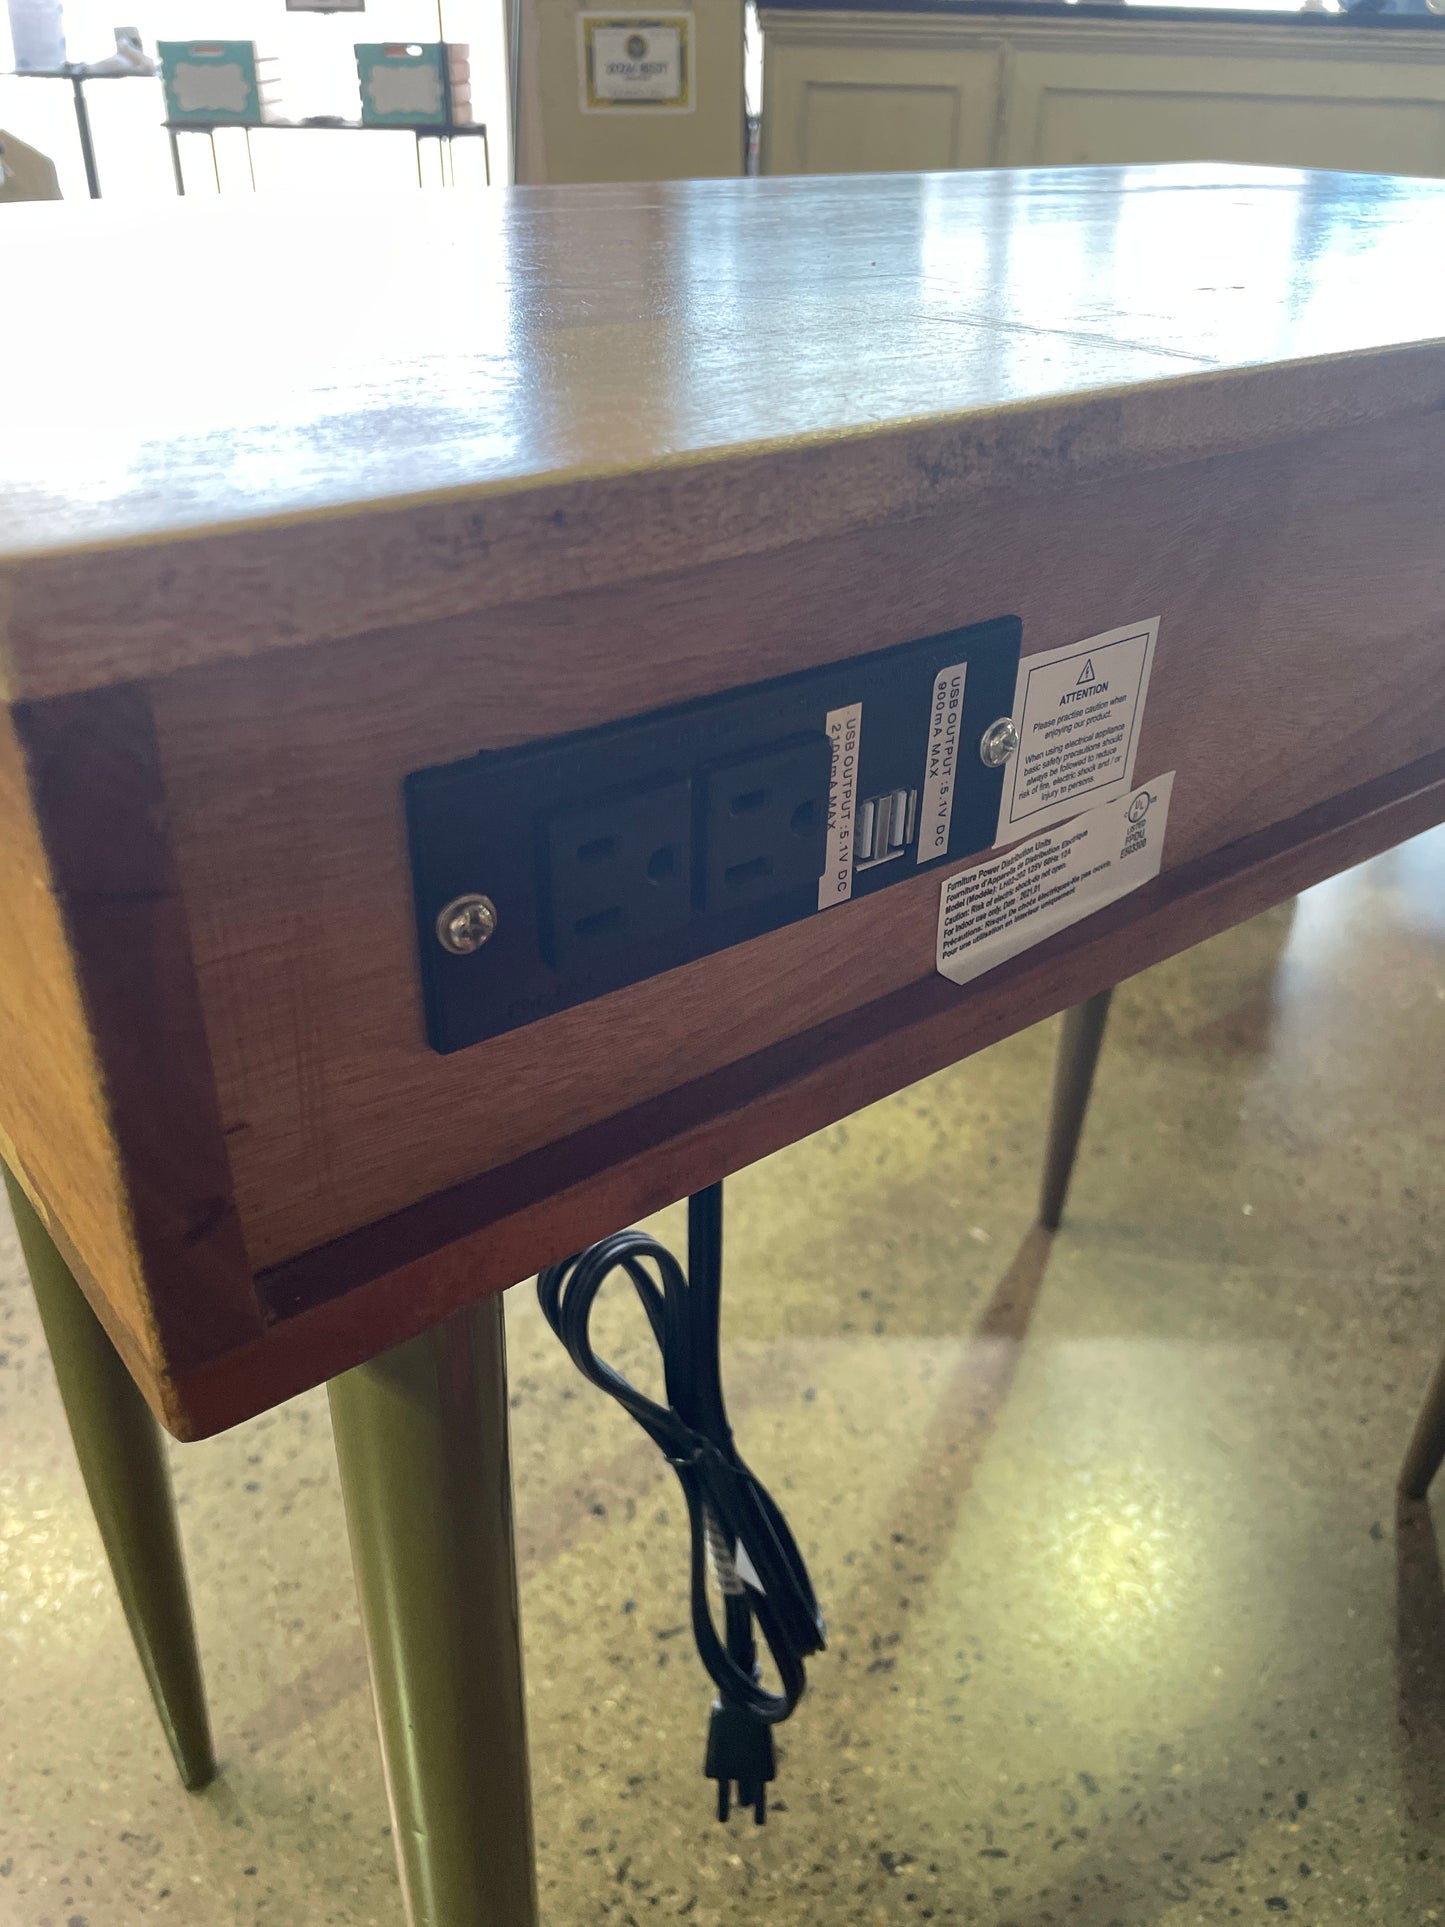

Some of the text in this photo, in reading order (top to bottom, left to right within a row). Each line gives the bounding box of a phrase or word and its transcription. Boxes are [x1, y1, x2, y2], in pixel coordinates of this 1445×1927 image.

[949, 677, 960, 709] USB
[1059, 681, 1108, 706] ATTENTION
[930, 681, 947, 778] 900mA MAX
[1033, 719, 1056, 733] Please
[1085, 701, 1108, 714] caution
[1044, 724, 1072, 739] enjoying
[1086, 710, 1111, 726] product.
[845, 718, 856, 751] USB
[942, 712, 956, 776] OUTPUT
[1025, 724, 1125, 764] When using electrical appliance
[1024, 734, 1123, 776] basic safety precautions should
[1026, 772, 1048, 786] always
[1060, 757, 1086, 772] followed
[1096, 747, 1117, 759] reduce
[841, 756, 854, 819] OUTPUT
[1053, 772, 1076, 786] electric
[1077, 764, 1096, 777] shock
[1068, 776, 1094, 792] persons.
[827, 796, 837, 830] MAX
[1127, 819, 1147, 836] LISTED
[935, 825, 945, 846] DC
[837, 869, 847, 892] DC
[946, 884, 980, 904] Fourniture
[1025, 845, 1060, 866] Distribution
[947, 874, 977, 893] Furniture
[978, 865, 1000, 879] Power
[1001, 846, 1034, 870] Distribution
[944, 909, 970, 926] Caution:
[994, 888, 1014, 904] electric
[945, 898, 965, 914] Model
[972, 924, 1004, 944] utilisation
[1041, 886, 1076, 909] uniquement
[985, 913, 1007, 928] Risque
